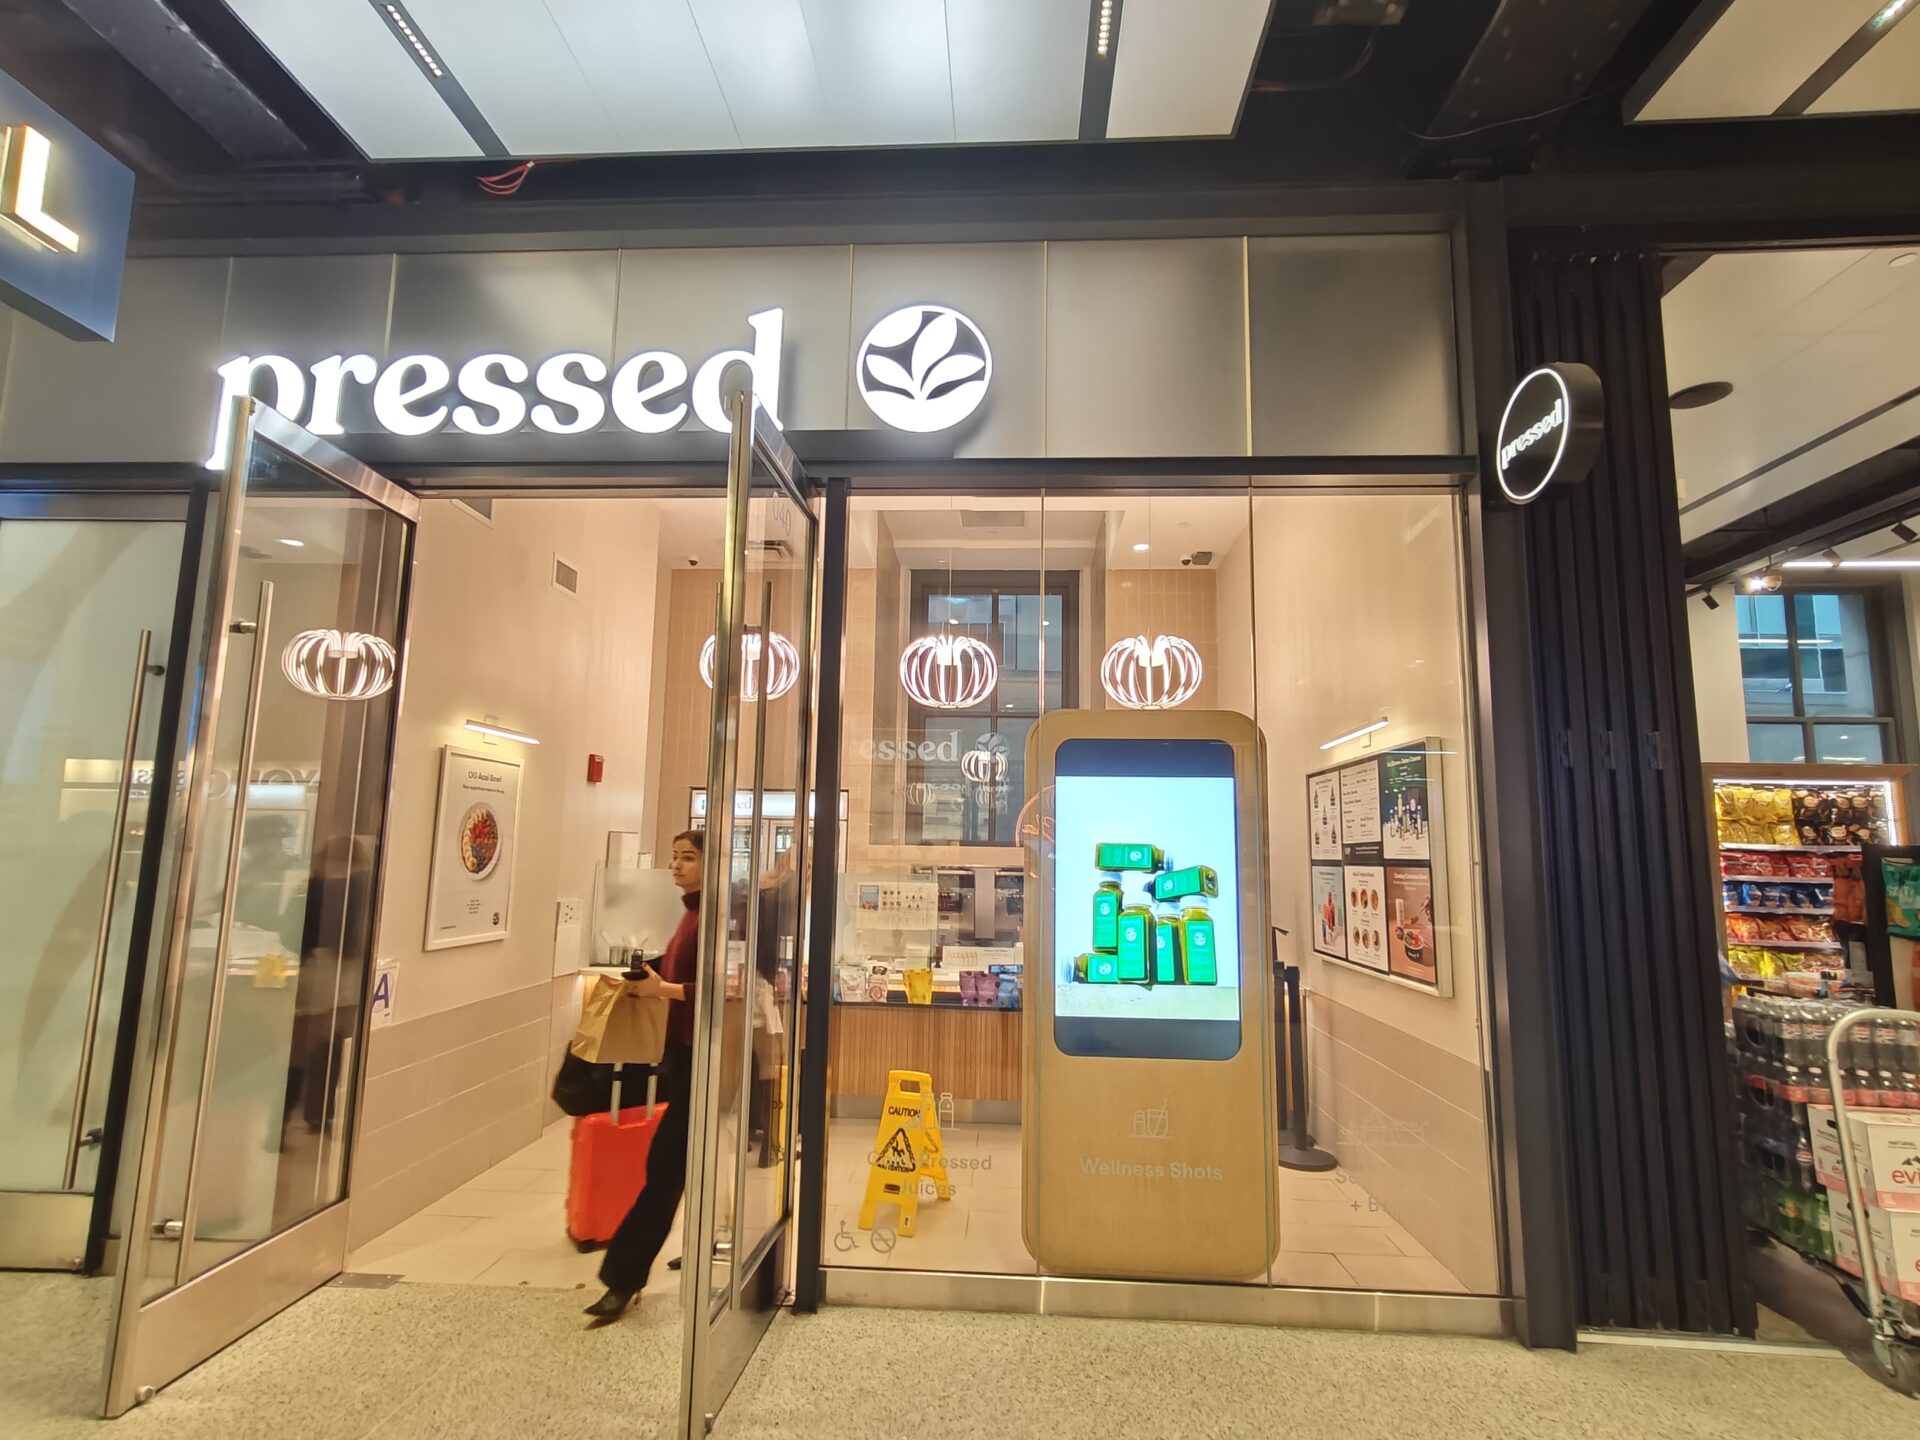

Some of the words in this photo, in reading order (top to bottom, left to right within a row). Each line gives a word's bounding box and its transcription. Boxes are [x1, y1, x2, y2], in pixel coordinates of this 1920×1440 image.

[204, 307, 784, 471] pressed
[1502, 398, 1563, 470] pressed
[888, 1106, 921, 1118] CAUTION
[1079, 1157, 1165, 1178] Wellness
[1170, 1161, 1223, 1180] Shots
